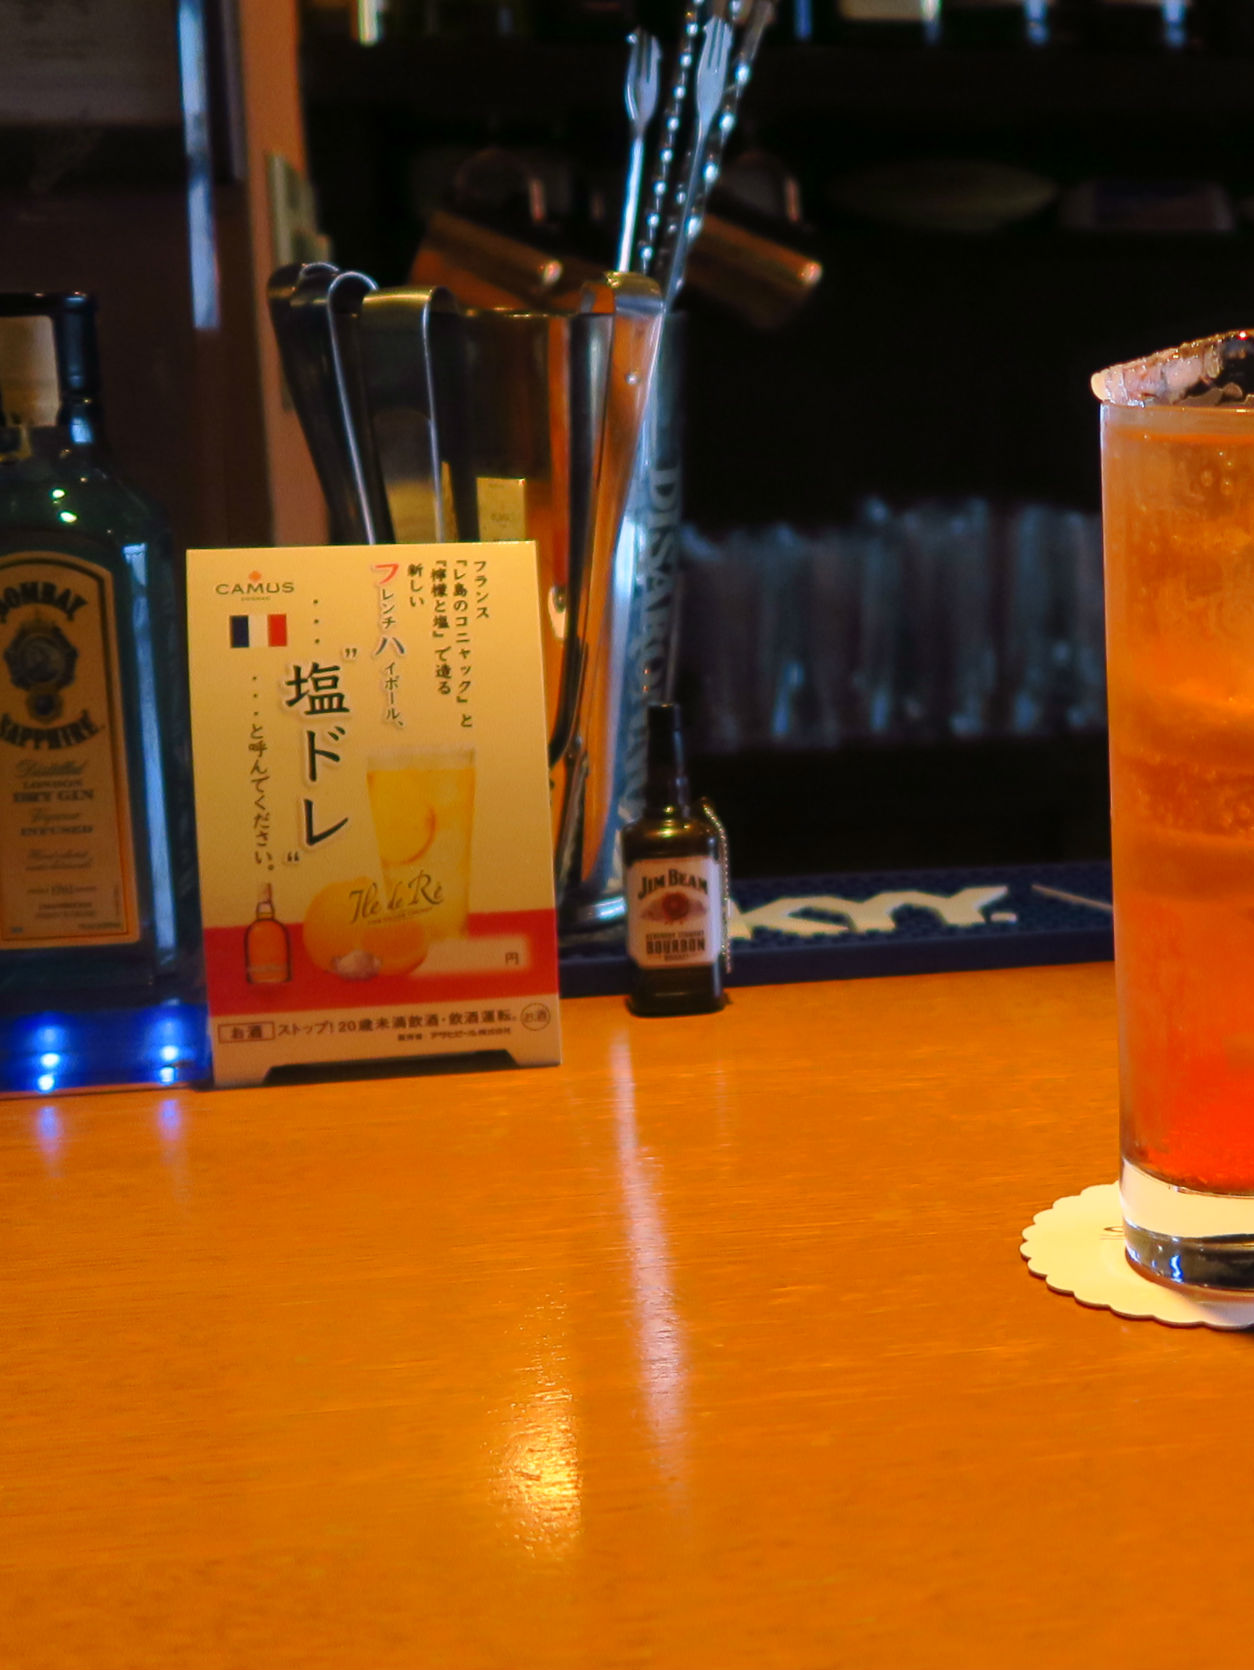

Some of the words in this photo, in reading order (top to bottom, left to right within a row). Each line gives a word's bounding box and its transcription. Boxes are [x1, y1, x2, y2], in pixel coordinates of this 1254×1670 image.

[215, 582, 295, 595] CAMUS
[407, 563, 424, 608] 新しい
[473, 560, 490, 619] フランス
[57, 788, 94, 801] GIN
[638, 875, 665, 899] JIM
[668, 868, 708, 895] BEAM
[646, 938, 706, 955] BOURBON
[505, 952, 519, 965] 円
[231, 1025, 263, 1040] お酒
